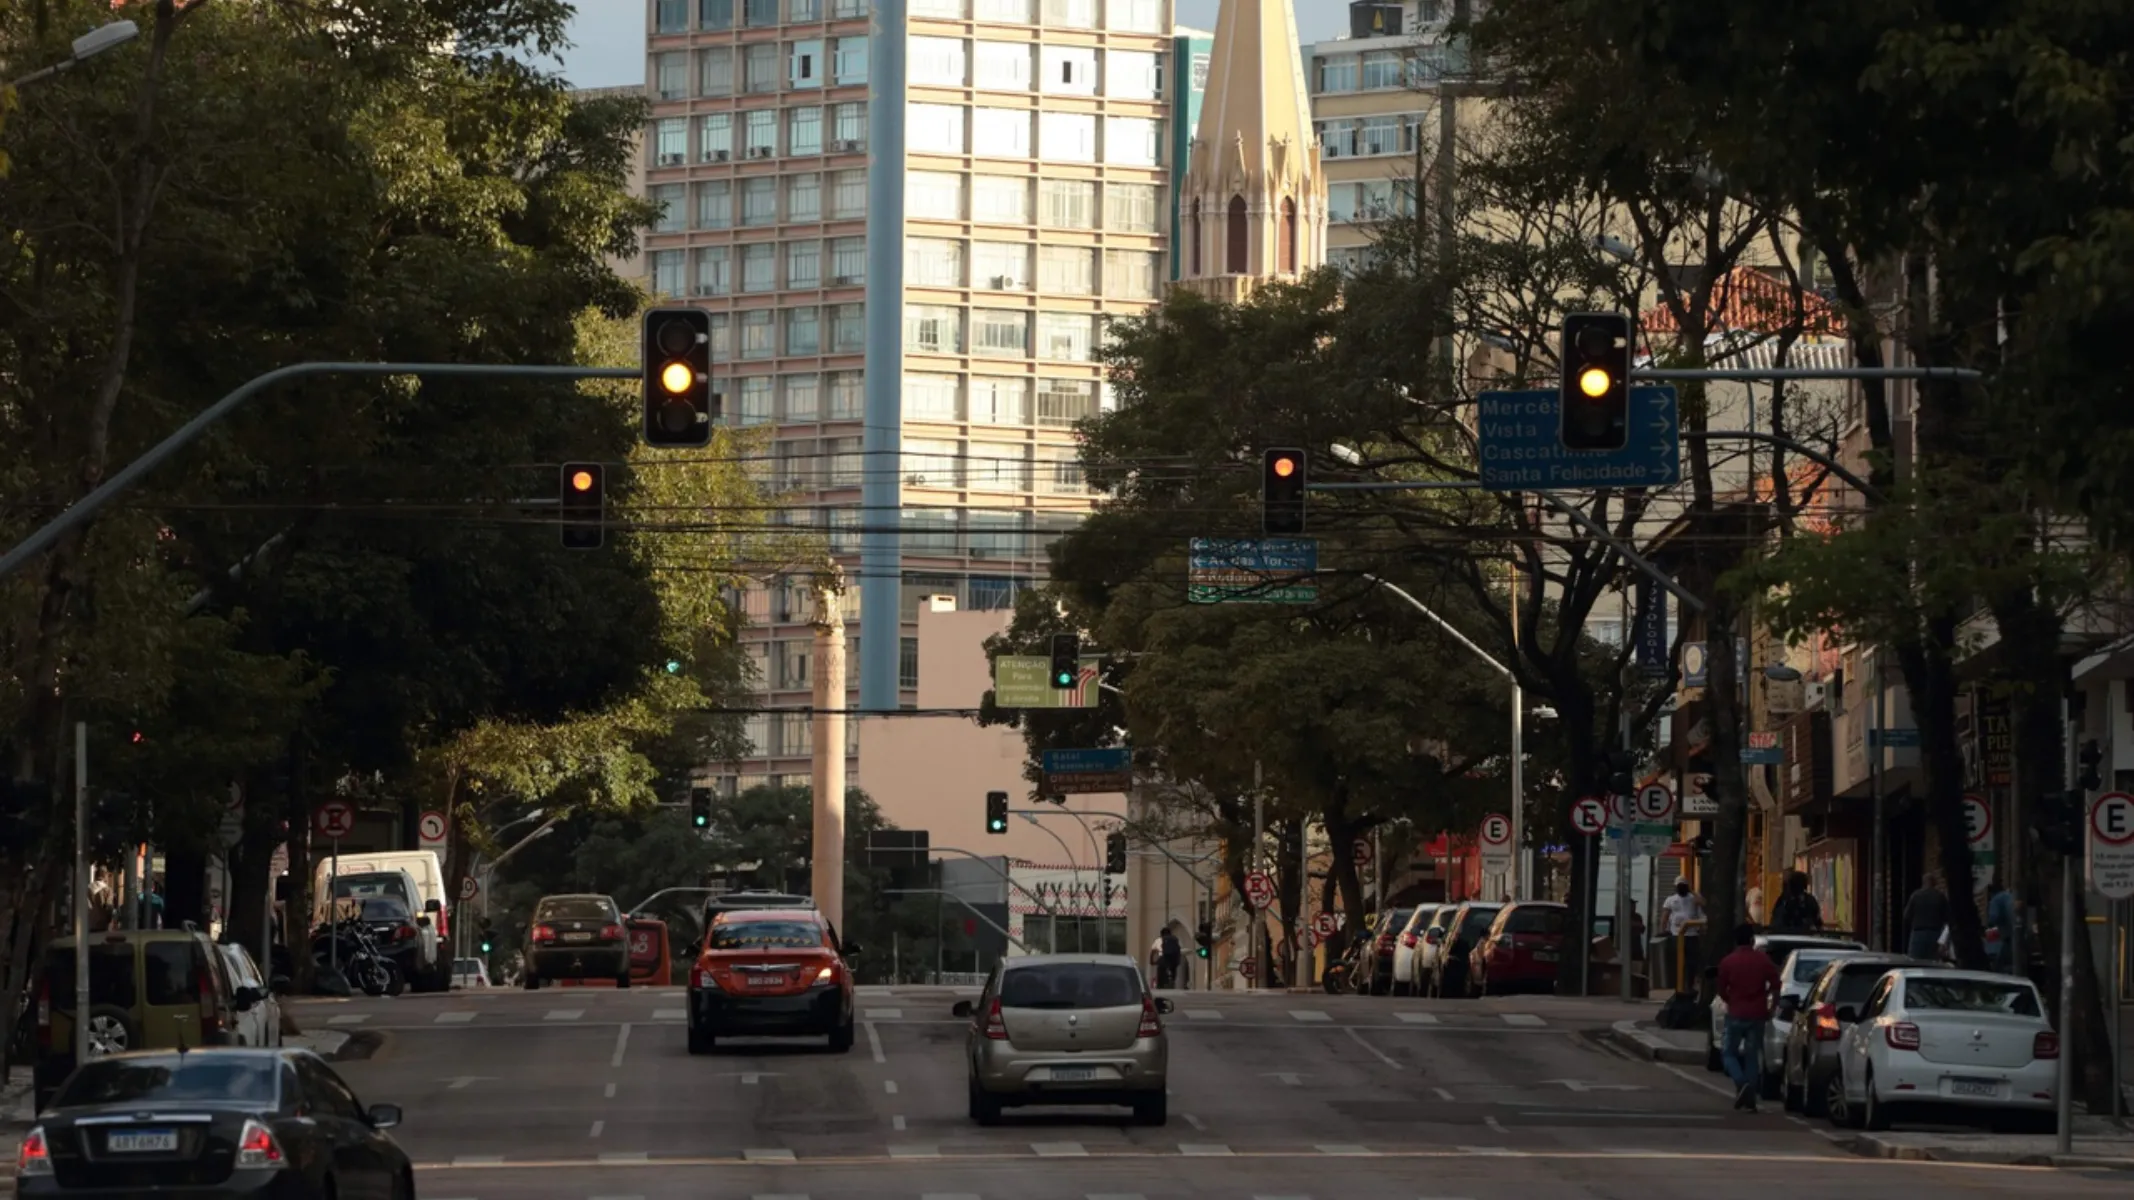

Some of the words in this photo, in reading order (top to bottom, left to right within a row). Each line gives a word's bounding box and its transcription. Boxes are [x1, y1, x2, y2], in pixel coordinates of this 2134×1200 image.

[1484, 422, 1537, 438] Vista
[1485, 466, 1542, 484] Santa
[1549, 461, 1647, 481] Felicidade
[1000, 659, 1046, 671] ATENÇÃO
[1649, 790, 1661, 810] E
[2107, 804, 2125, 833] E
[1491, 821, 1502, 838] E
